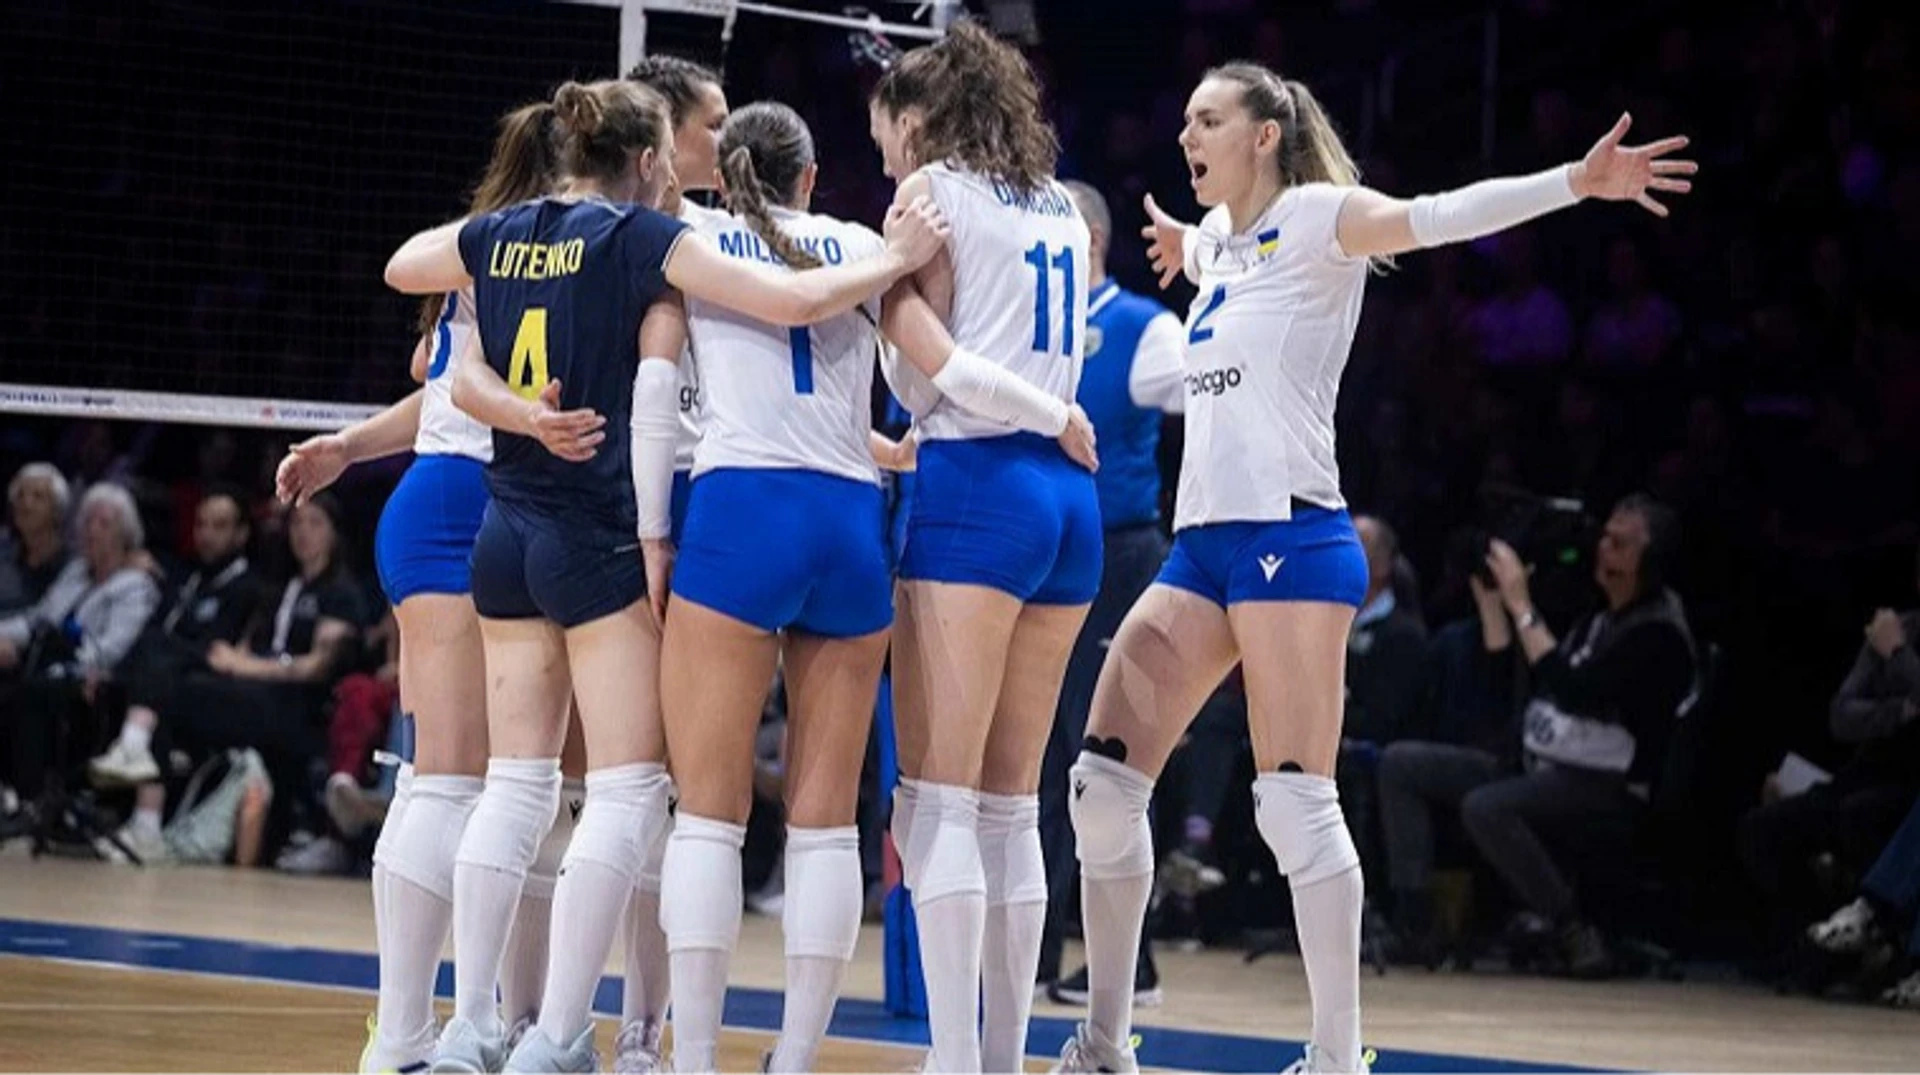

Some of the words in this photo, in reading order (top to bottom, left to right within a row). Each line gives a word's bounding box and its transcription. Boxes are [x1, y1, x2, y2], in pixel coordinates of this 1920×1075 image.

[1024, 240, 1075, 358] 11
[1189, 283, 1226, 345] 2
[507, 306, 550, 401] 4
